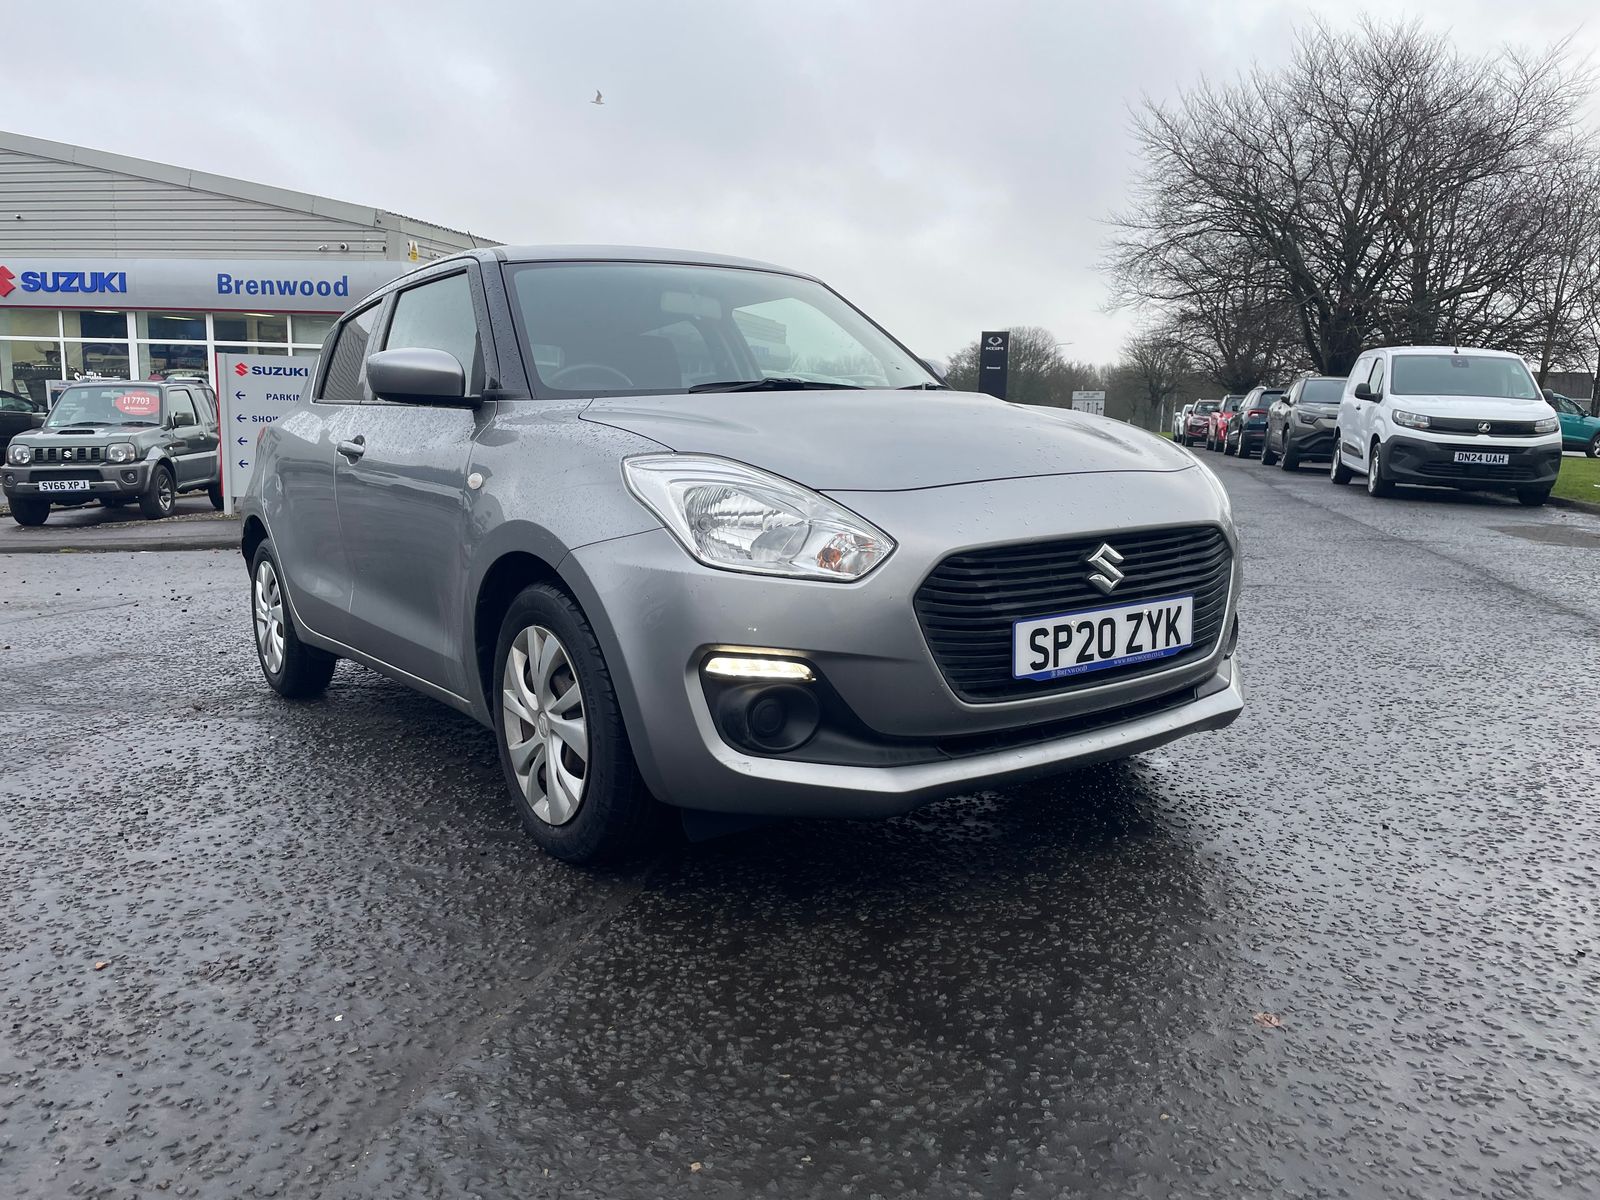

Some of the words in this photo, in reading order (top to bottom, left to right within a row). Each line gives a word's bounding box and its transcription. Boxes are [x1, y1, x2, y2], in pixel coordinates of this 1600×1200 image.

[20, 271, 127, 293] SUZUKI
[216, 273, 349, 297] Brenwood
[251, 366, 309, 377] SUZUKI
[123, 396, 150, 405] £17703
[1458, 452, 1482, 462] DN24
[1485, 454, 1505, 463] UAH
[42, 482, 66, 490] SV66
[67, 481, 86, 489] XPJ
[1029, 617, 1116, 671] SP20
[1126, 605, 1182, 655] ZYK
